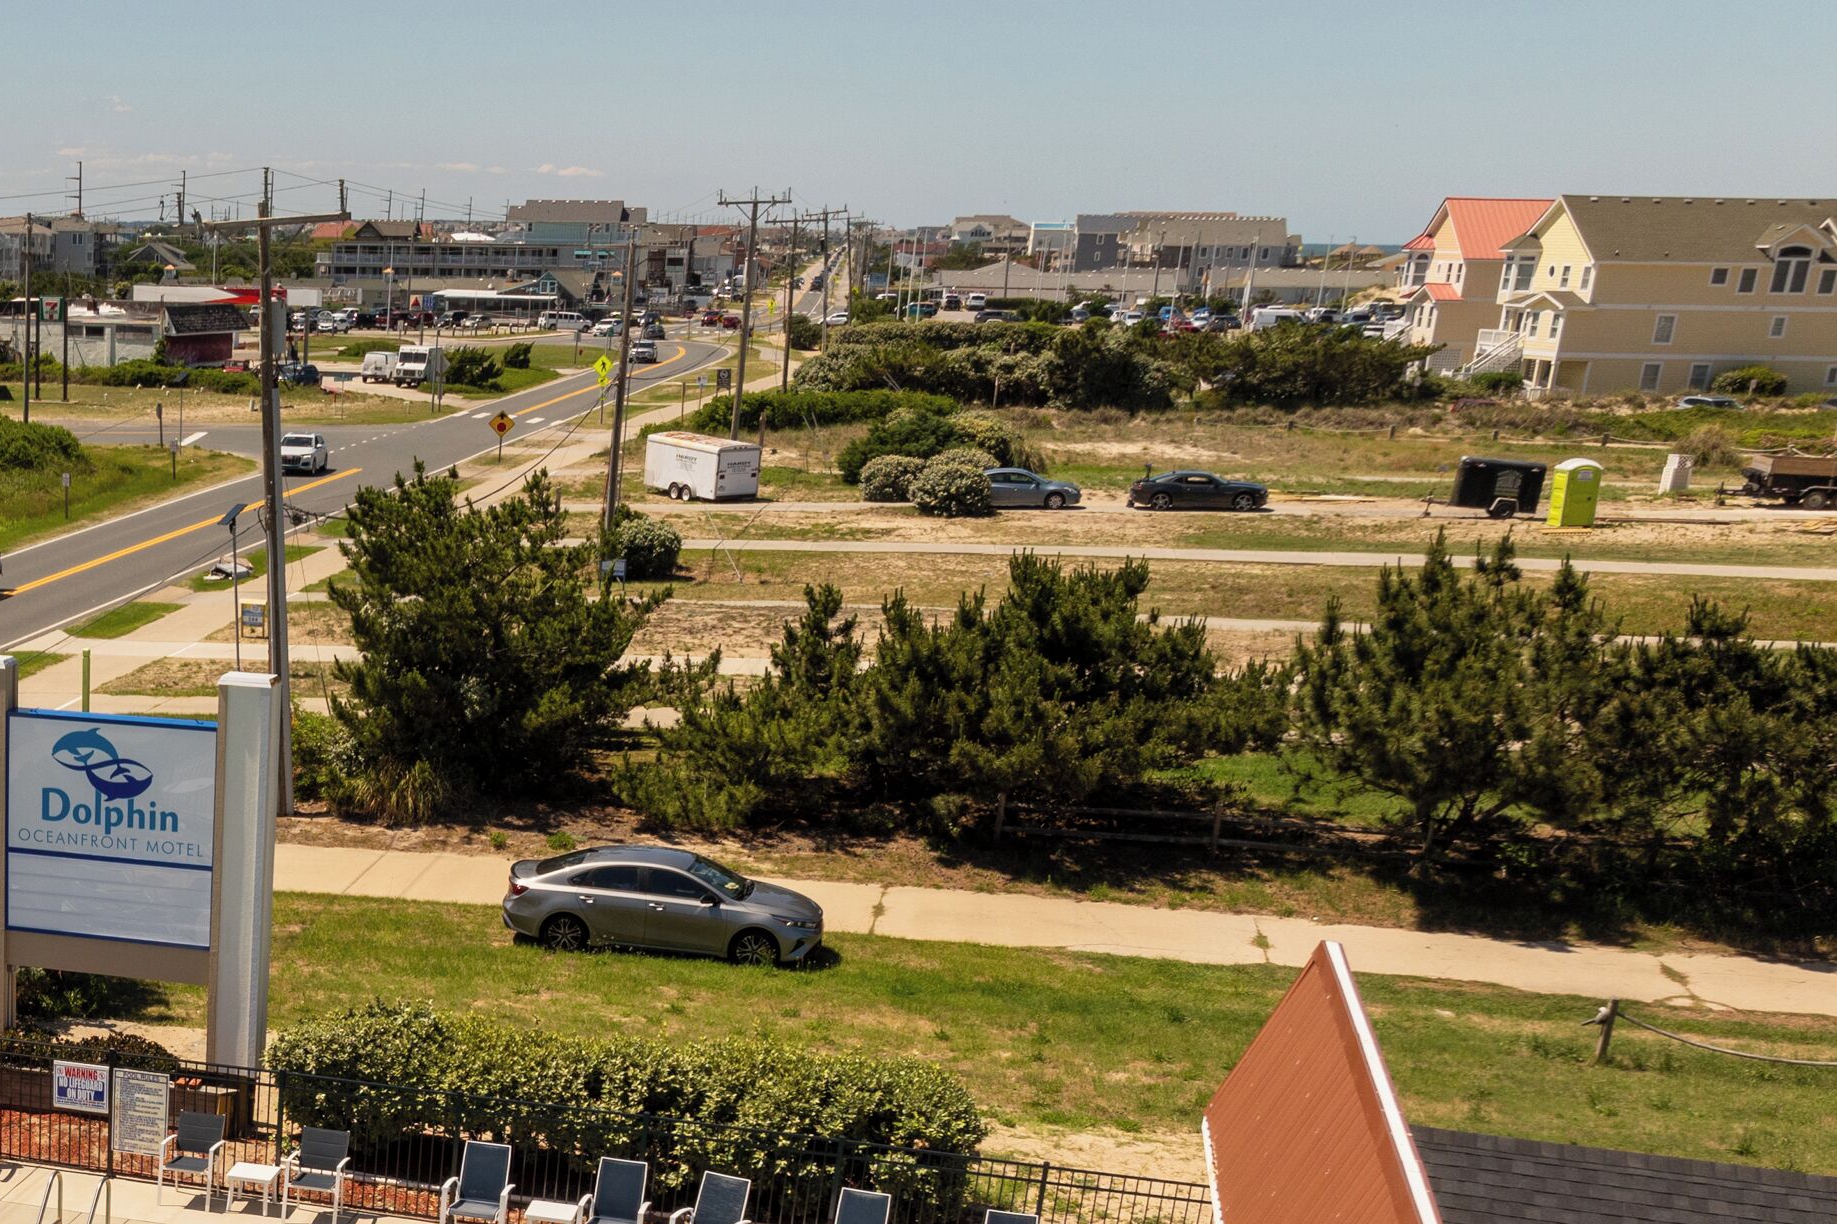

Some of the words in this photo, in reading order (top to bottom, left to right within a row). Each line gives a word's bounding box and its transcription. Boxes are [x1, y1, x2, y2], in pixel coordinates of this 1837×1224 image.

[41, 787, 179, 834] Dolphin
[18, 827, 138, 851] OCEANFRONT
[146, 841, 204, 858] MOTEL
[65, 1066, 98, 1081] WARNING
[58, 1077, 69, 1088] NO
[69, 1078, 103, 1092] LIFEGUARD
[66, 1088, 76, 1099] ON
[77, 1089, 95, 1101] DUTY
